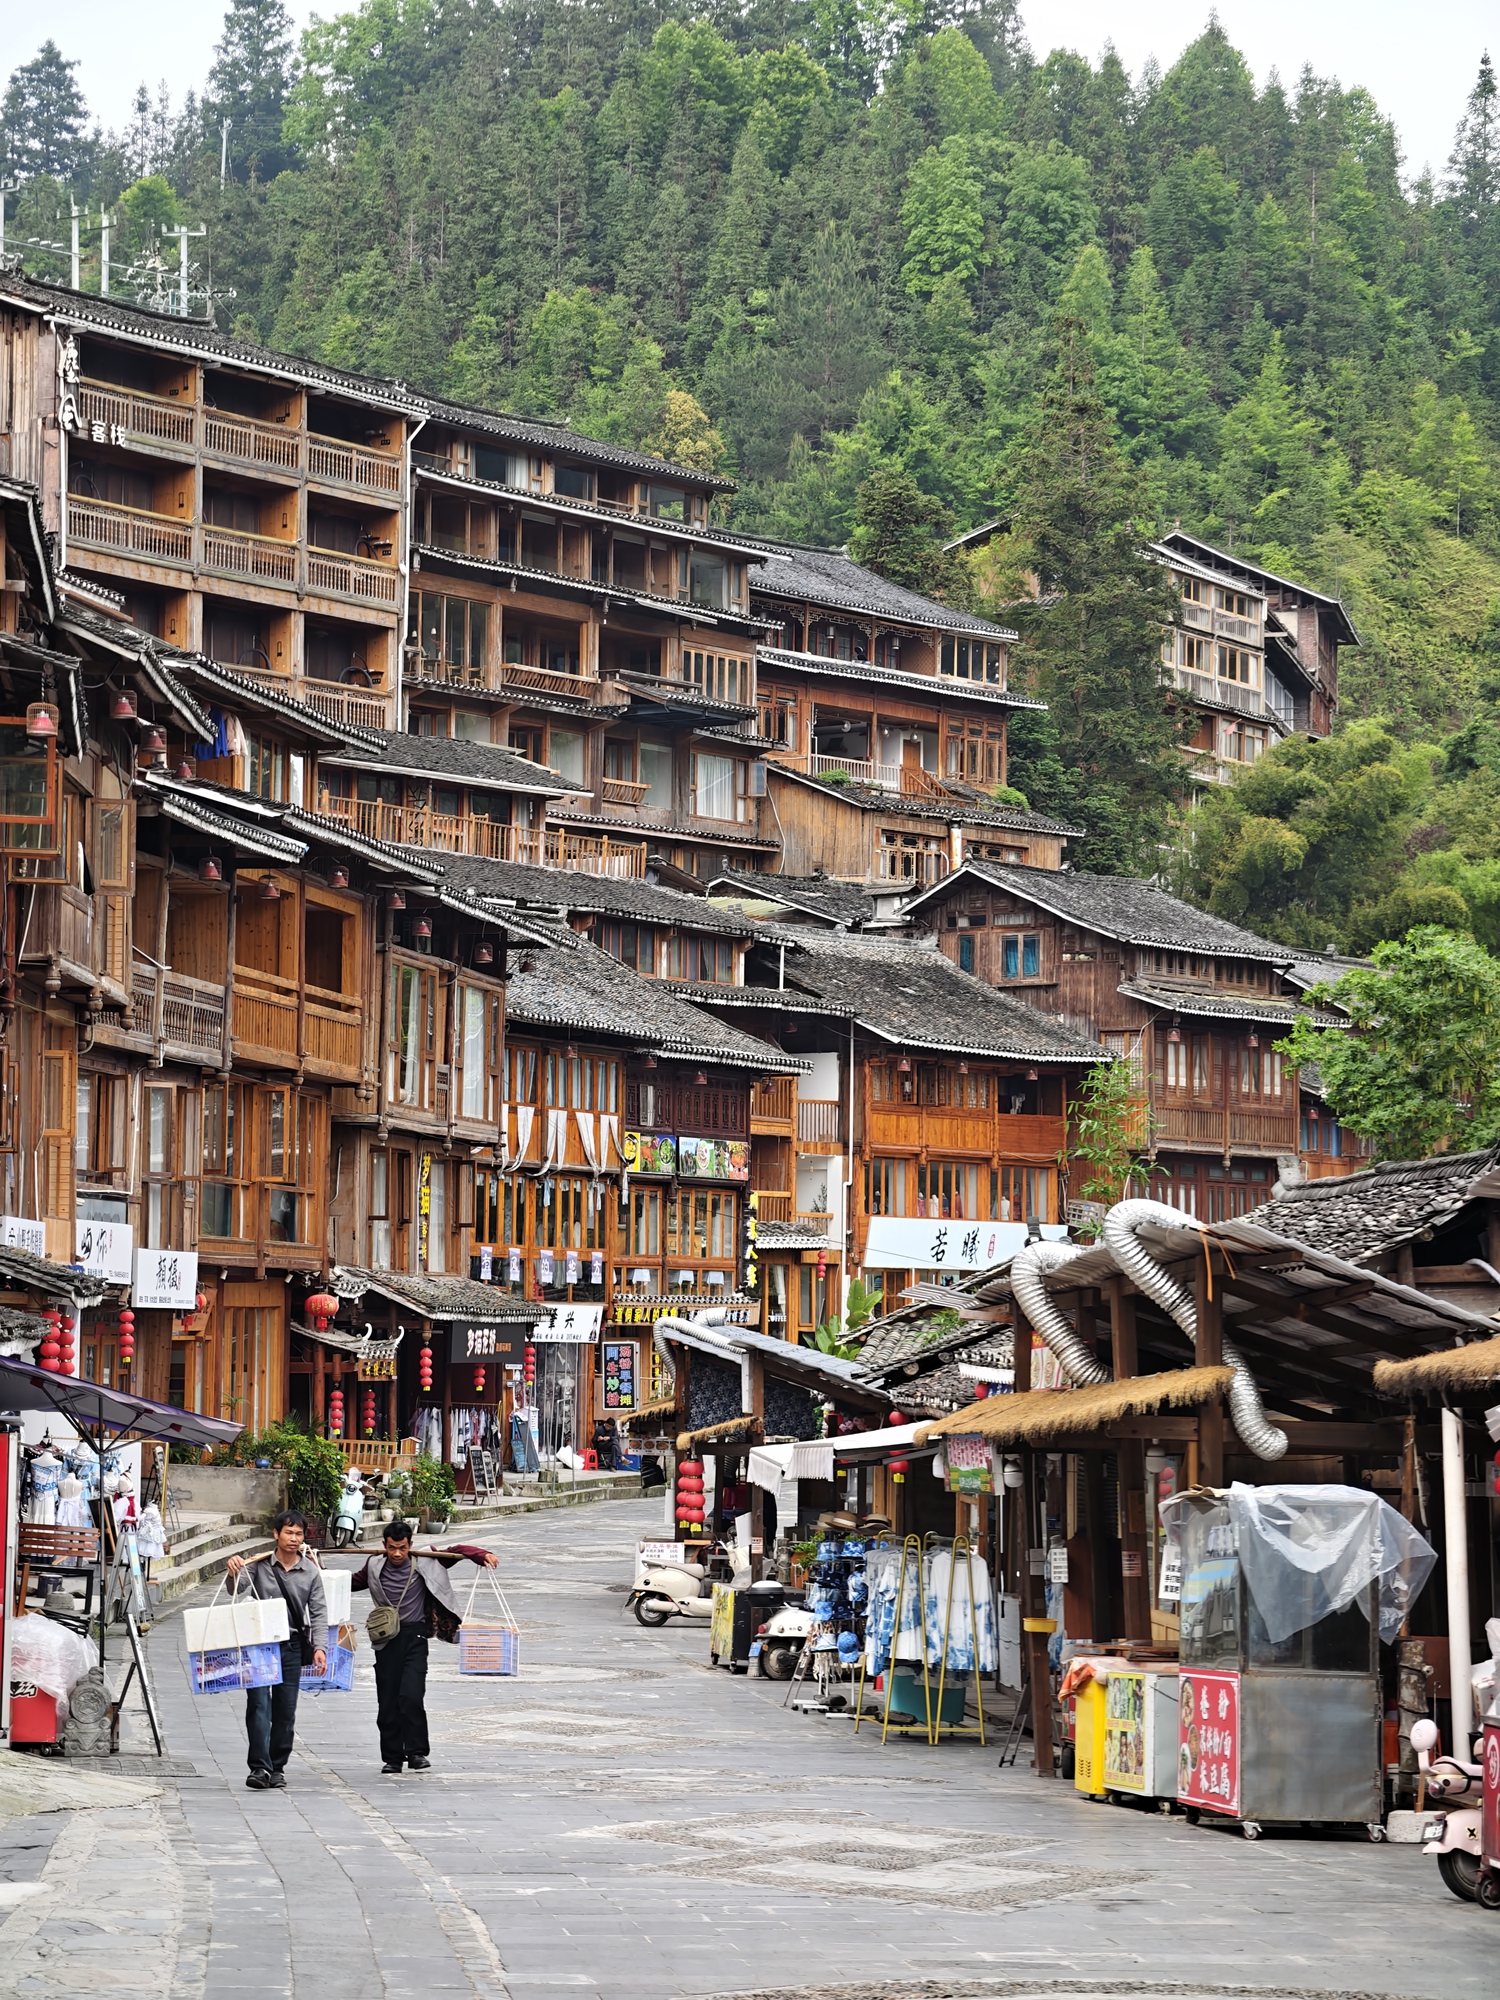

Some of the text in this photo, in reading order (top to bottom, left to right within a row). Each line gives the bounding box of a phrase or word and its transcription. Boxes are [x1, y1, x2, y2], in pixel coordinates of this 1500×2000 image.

[91, 420, 126, 447] 客栈
[606, 1346, 620, 1406] 阿生炒粉
[619, 1346, 632, 1406] 汤粉早餐摊
[1199, 1759, 1231, 1801] 米豆腐
